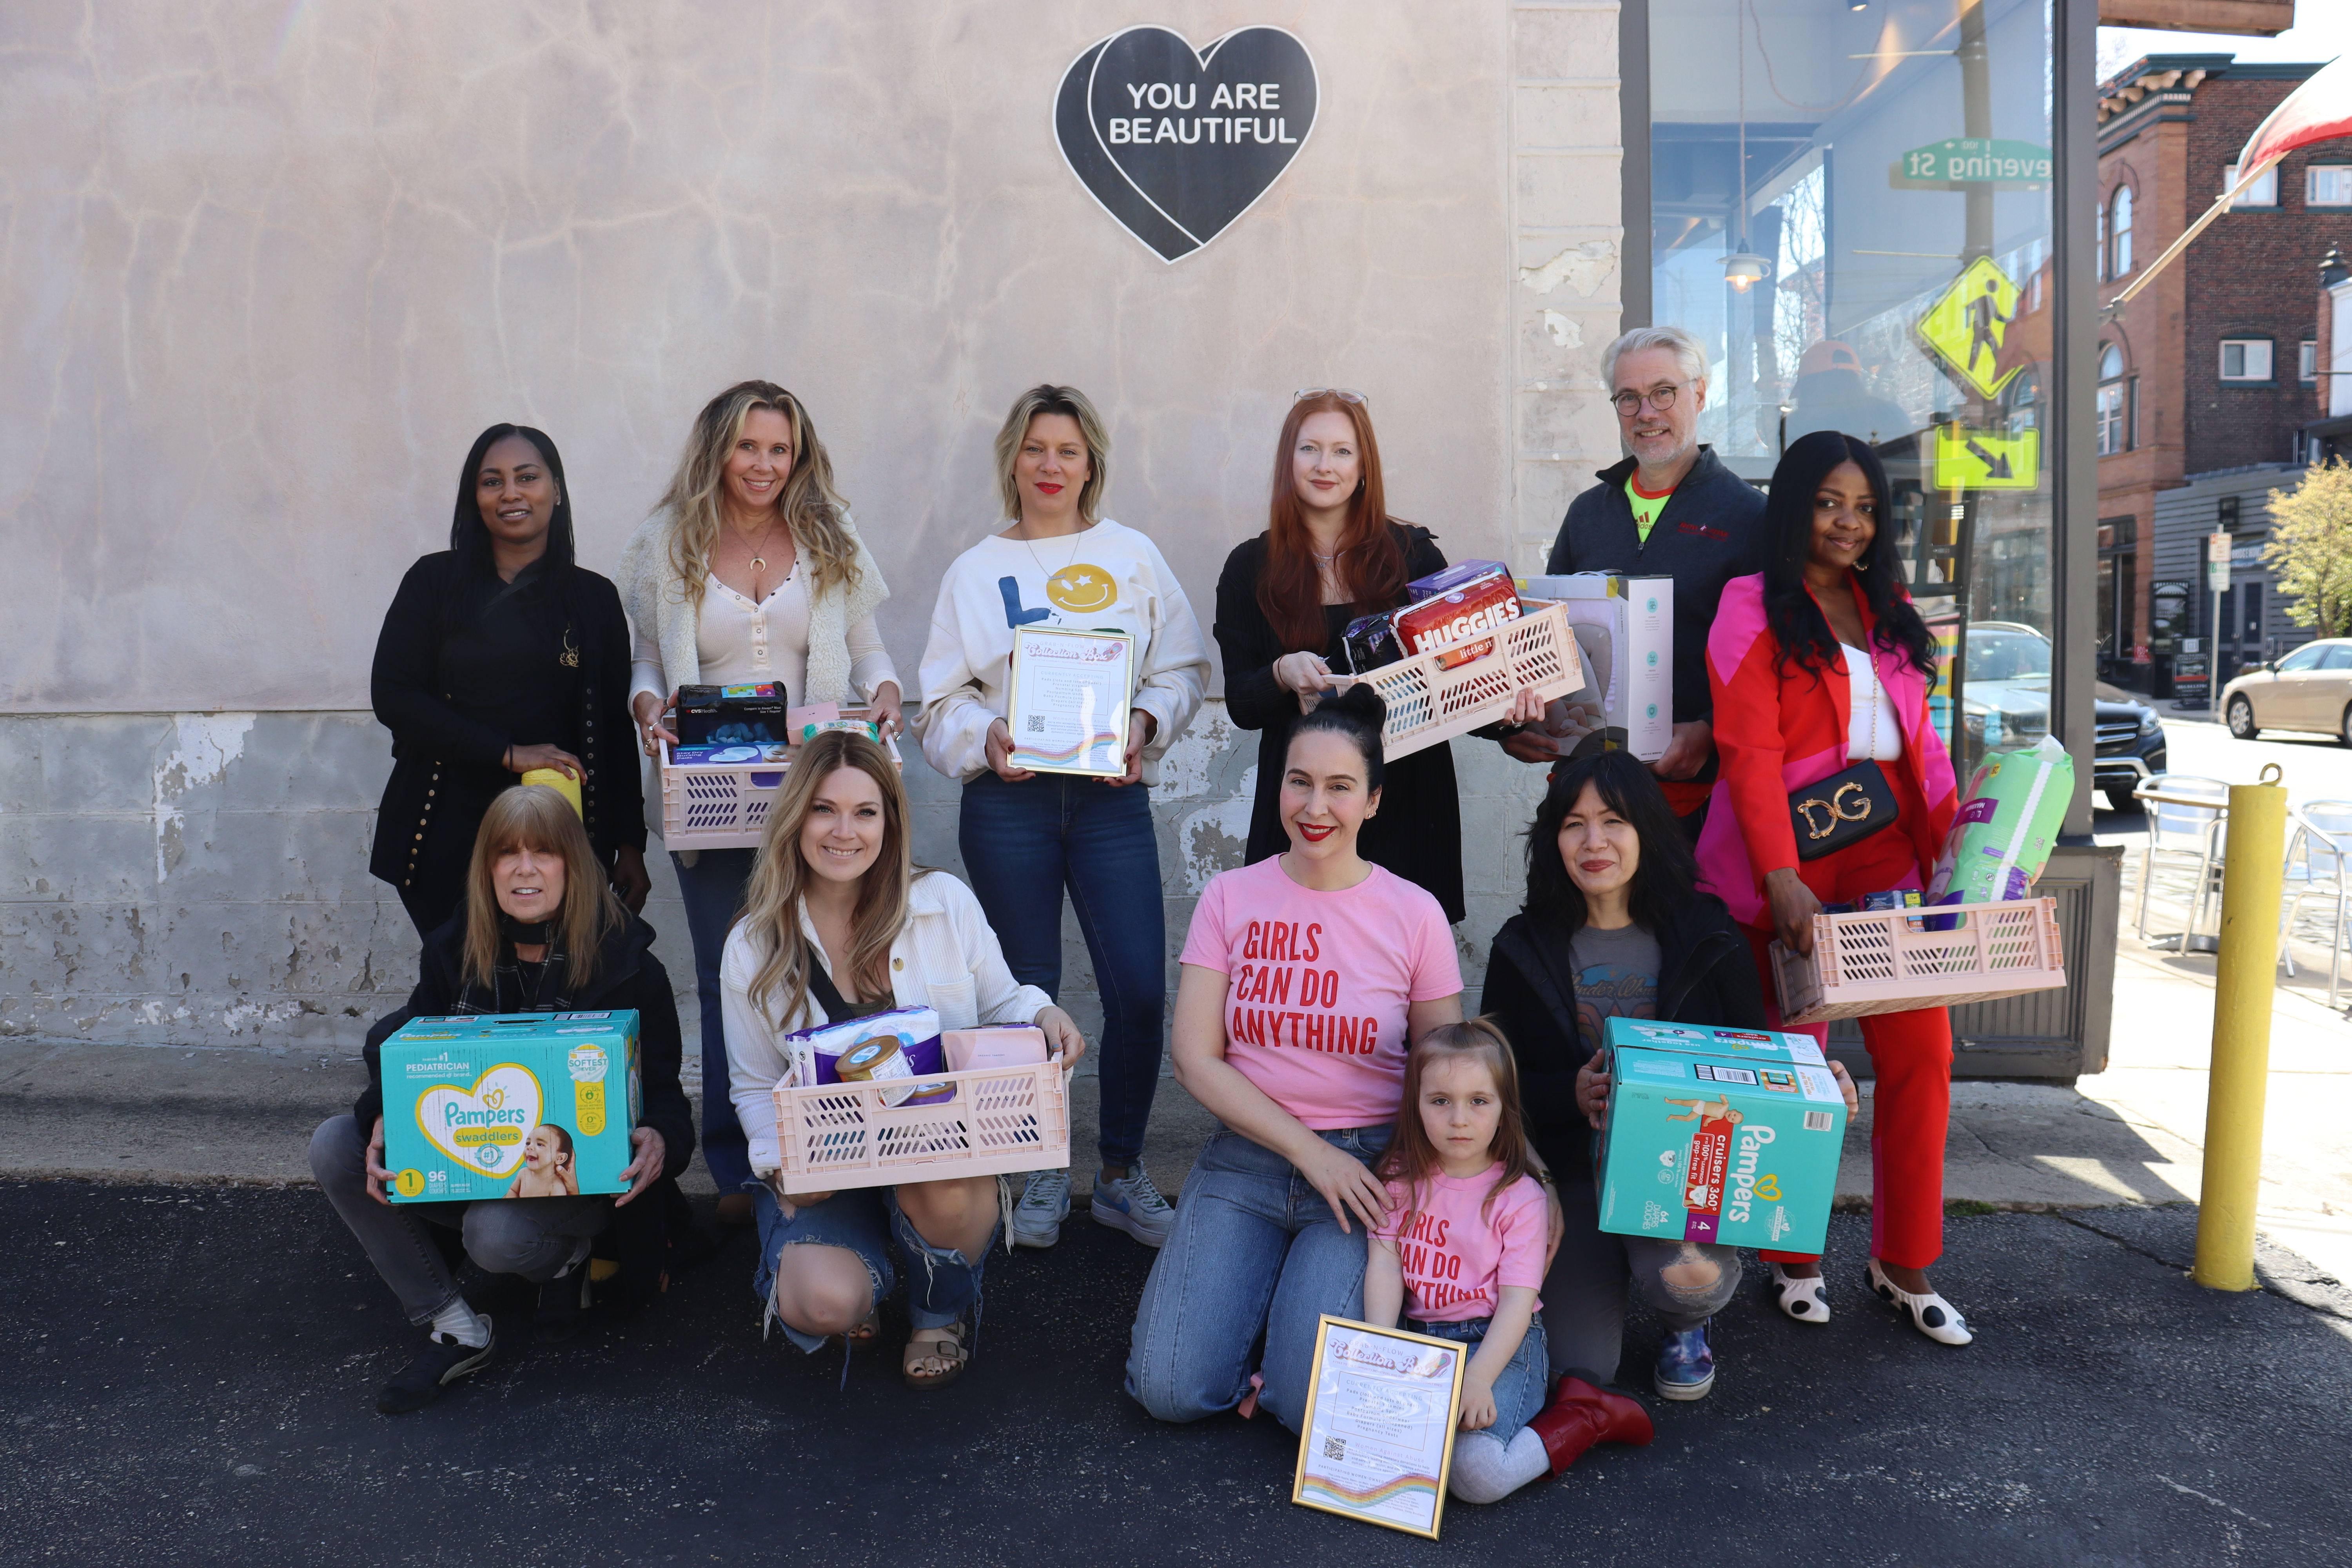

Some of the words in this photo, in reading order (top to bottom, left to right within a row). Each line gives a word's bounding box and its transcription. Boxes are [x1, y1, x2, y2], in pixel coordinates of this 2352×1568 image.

[1127, 82, 1196, 109] YOU
[1210, 83, 1280, 109] ARE
[1109, 117, 1297, 144] BEAUTIFUL
[2232, 549, 2249, 559] BRIDGE
[1412, 597, 1520, 654] HUGGIES
[1459, 641, 1484, 659] little
[1991, 766, 2000, 775] 28
[1797, 782, 1872, 840] DG
[1243, 920, 1322, 962] GIRLS
[1236, 964, 1292, 1005] CAN
[1300, 968, 1339, 1009] DO
[1232, 1006, 1378, 1055] ANYTHING
[439, 1052, 448, 1062] #1
[568, 1058, 608, 1067] SOFTEST
[406, 1062, 470, 1072] PEDIATRICIAN
[445, 1101, 525, 1128] Pampers
[456, 1132, 519, 1143] swaddlers
[483, 1151, 495, 1159] #1
[1691, 1140, 1701, 1171] gap-free
[1701, 1144, 1710, 1161] 100%
[1711, 1134, 1726, 1184] cruisers
[405, 1172, 413, 1187] 1
[428, 1171, 447, 1182] 96
[1728, 1125, 1776, 1223] Pampers
[1707, 1187, 1720, 1211] 360°
[1642, 1200, 1653, 1230] COUCHES
[1650, 1204, 1661, 1228] DIAPERS
[1659, 1210, 1669, 1223] 64
[1773, 1207, 1782, 1240] PEDIATRICIAN
[1697, 1221, 1711, 1231] 4
[1399, 1241, 1428, 1276] AN
[1432, 1251, 1461, 1280] DO
[1329, 1338, 1394, 1371] Collection
[1349, 1339, 1403, 1356] GRAB-N-FLOW
[1346, 1379, 1383, 1392] CURRENTLY
[1385, 1388, 1423, 1401] ACCEPTING
[1359, 1397, 1381, 1405] Prenatal
[1382, 1402, 1405, 1411] Vitamins
[1362, 1403, 1384, 1412] Numbing
[1351, 1406, 1380, 1417] Postpartum
[1382, 1414, 1410, 1423] Underwear
[1355, 1418, 1375, 1427] Diapers
[1360, 1414, 1381, 1422] Formula
[1383, 1419, 1412, 1430] (unopened)
[1357, 1425, 1383, 1435] Pregnancy
[1355, 1442, 1377, 1452] Women
[1379, 1448, 1403, 1459] Against
[1405, 1454, 1425, 1463] Abuse
[1318, 1464, 1350, 1475] PARTICIPATING
[1351, 1472, 1384, 1484] WOMEN-OWNED
